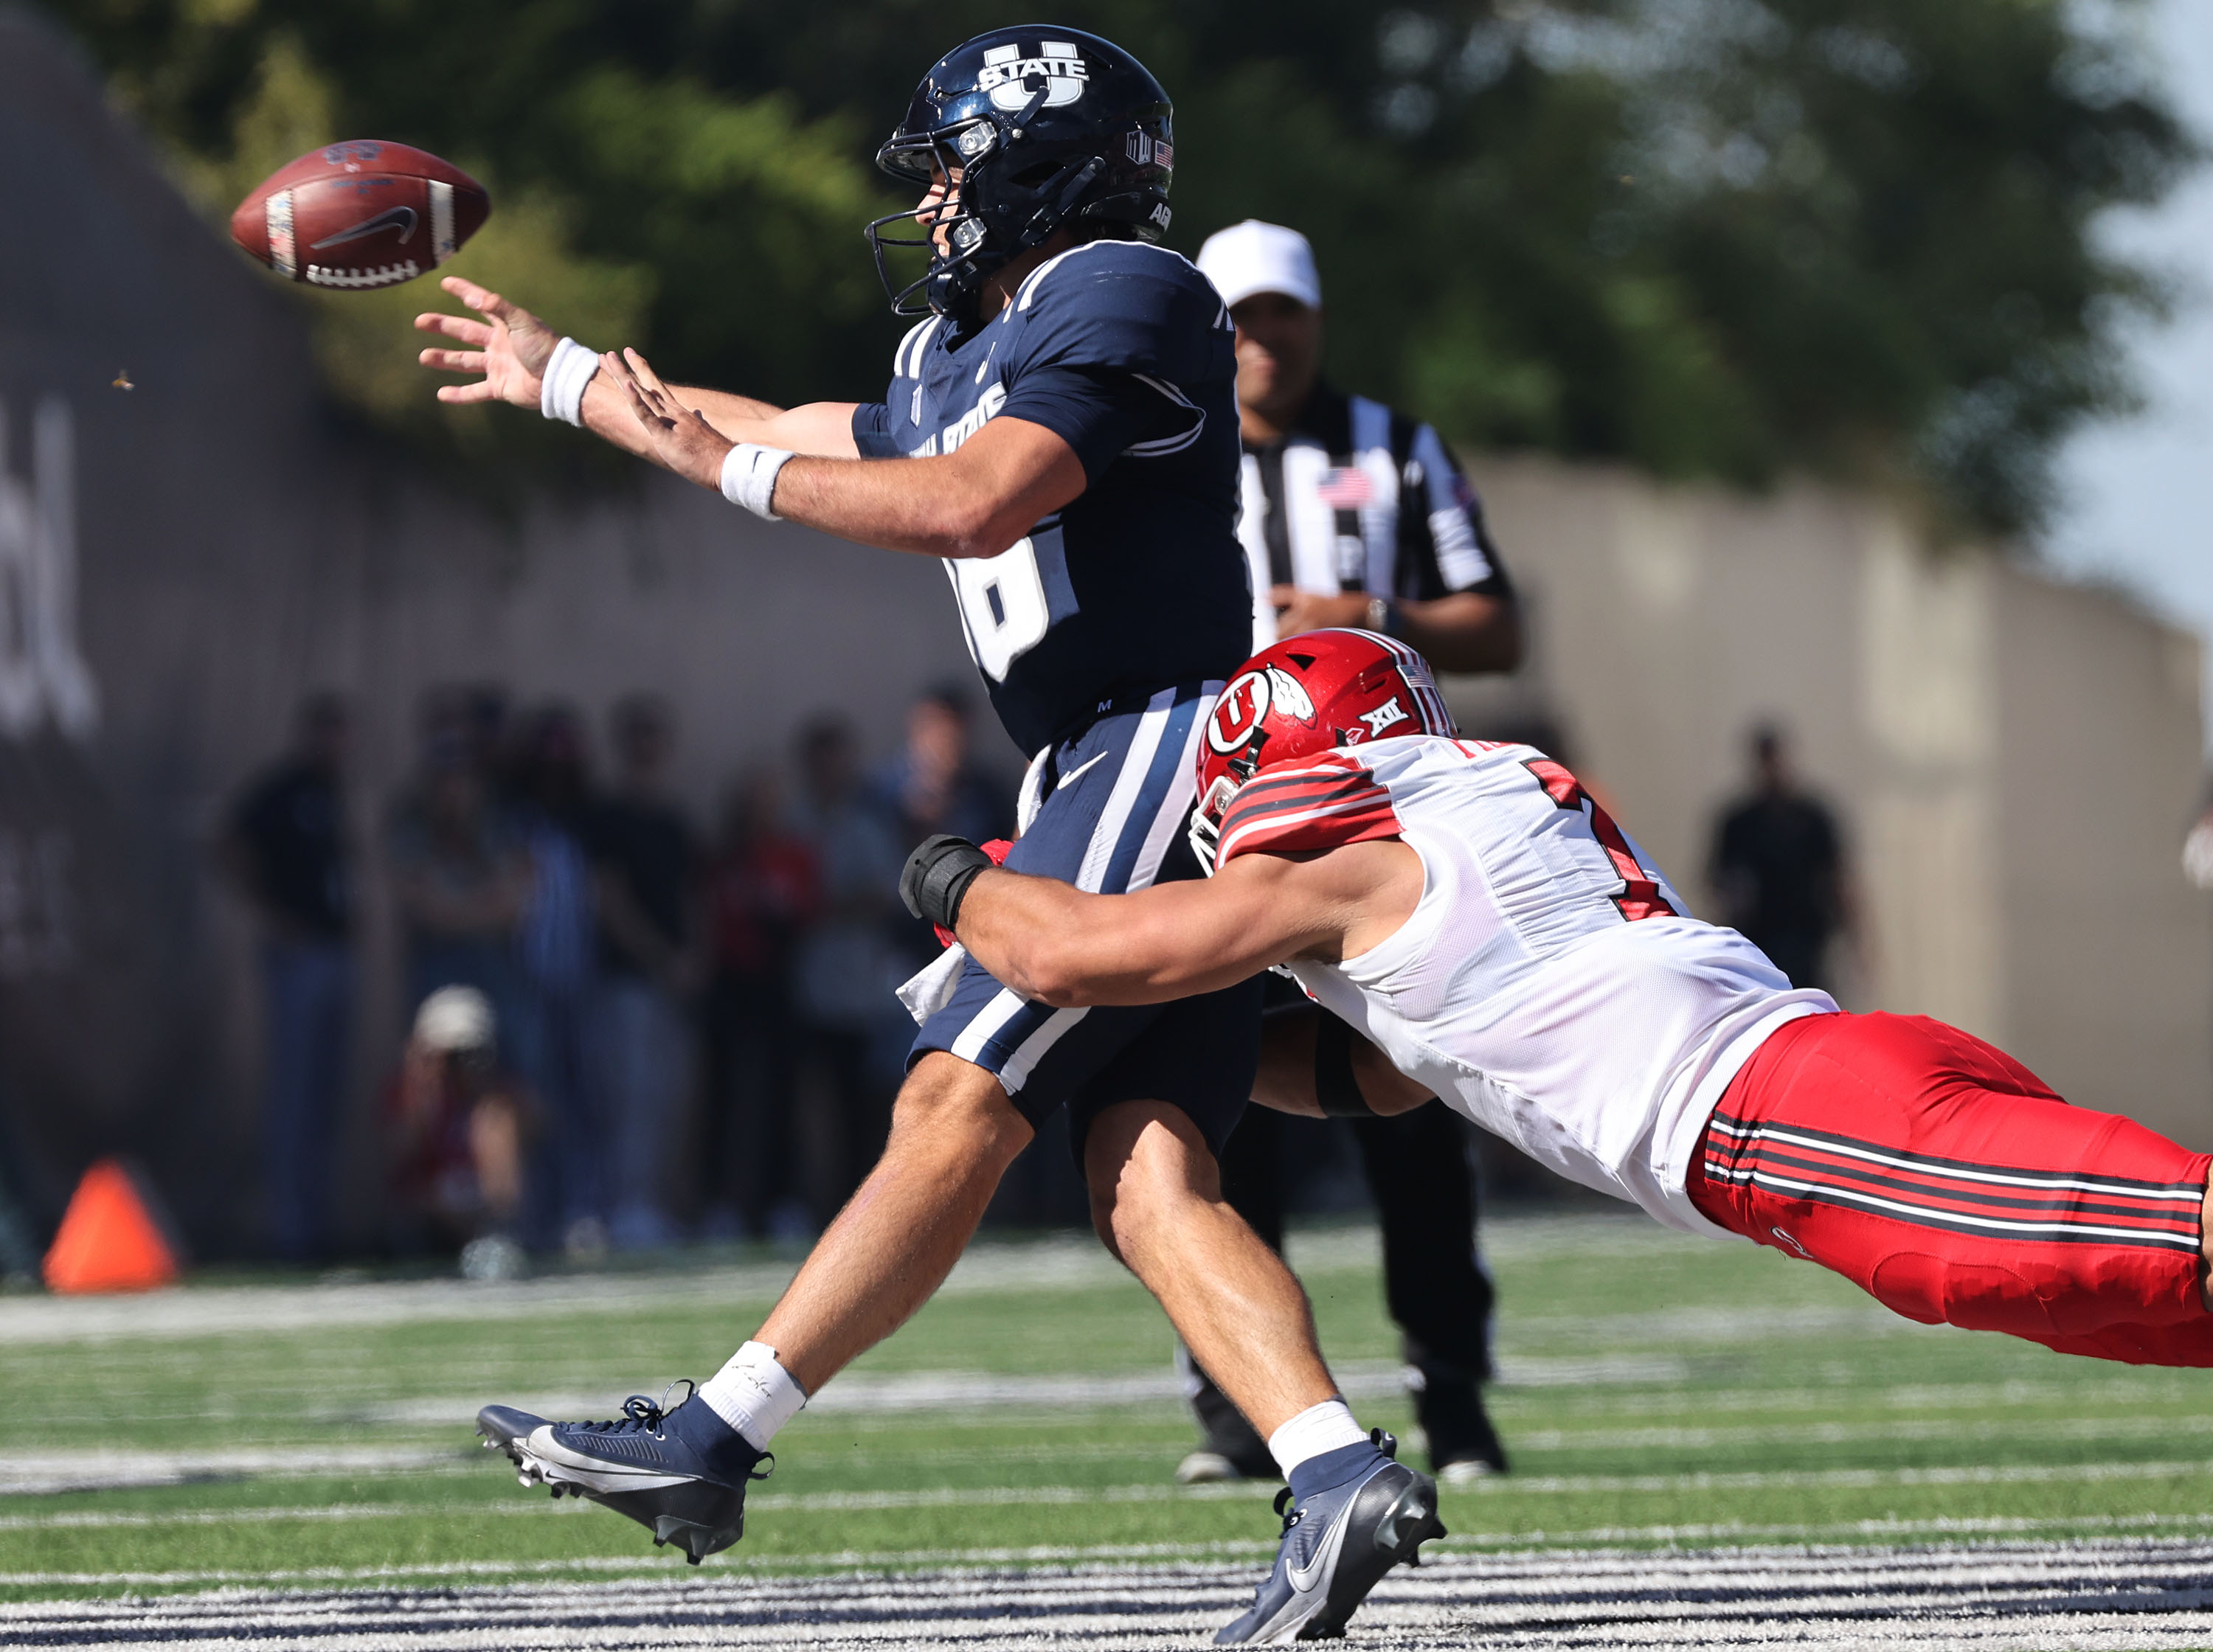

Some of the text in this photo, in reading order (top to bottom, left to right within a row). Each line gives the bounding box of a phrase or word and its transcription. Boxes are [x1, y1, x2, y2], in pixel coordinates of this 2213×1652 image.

[978, 58, 1090, 93] STATE
[984, 41, 1084, 111] U
[1215, 676, 1256, 743] U
[1358, 696, 1409, 738] XII
[1519, 757, 1680, 922] 7
